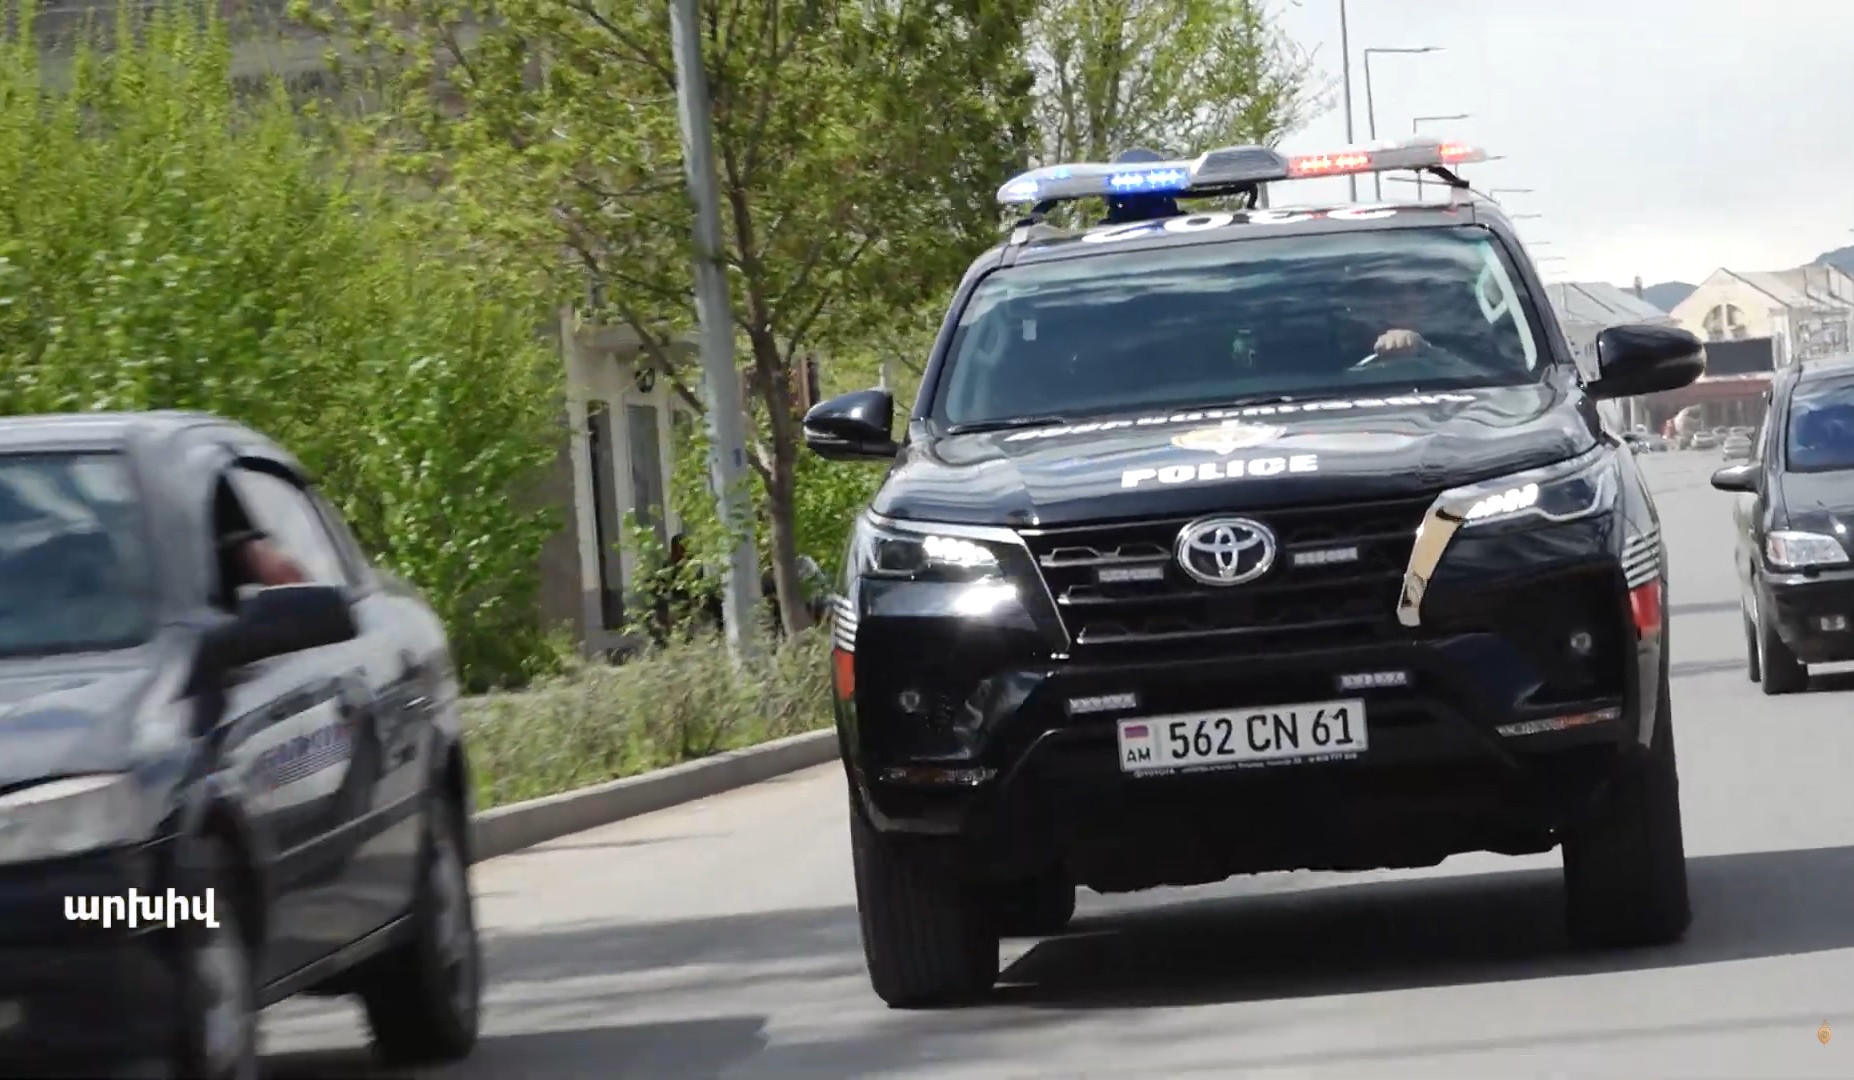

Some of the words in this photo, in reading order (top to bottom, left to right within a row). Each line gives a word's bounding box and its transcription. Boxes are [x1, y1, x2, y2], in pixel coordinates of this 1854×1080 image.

[1121, 454, 1318, 488] POLICE
[1168, 718, 1235, 759] 562
[1246, 712, 1299, 752] CN
[1311, 706, 1354, 746] 61
[1126, 747, 1151, 763] AM
